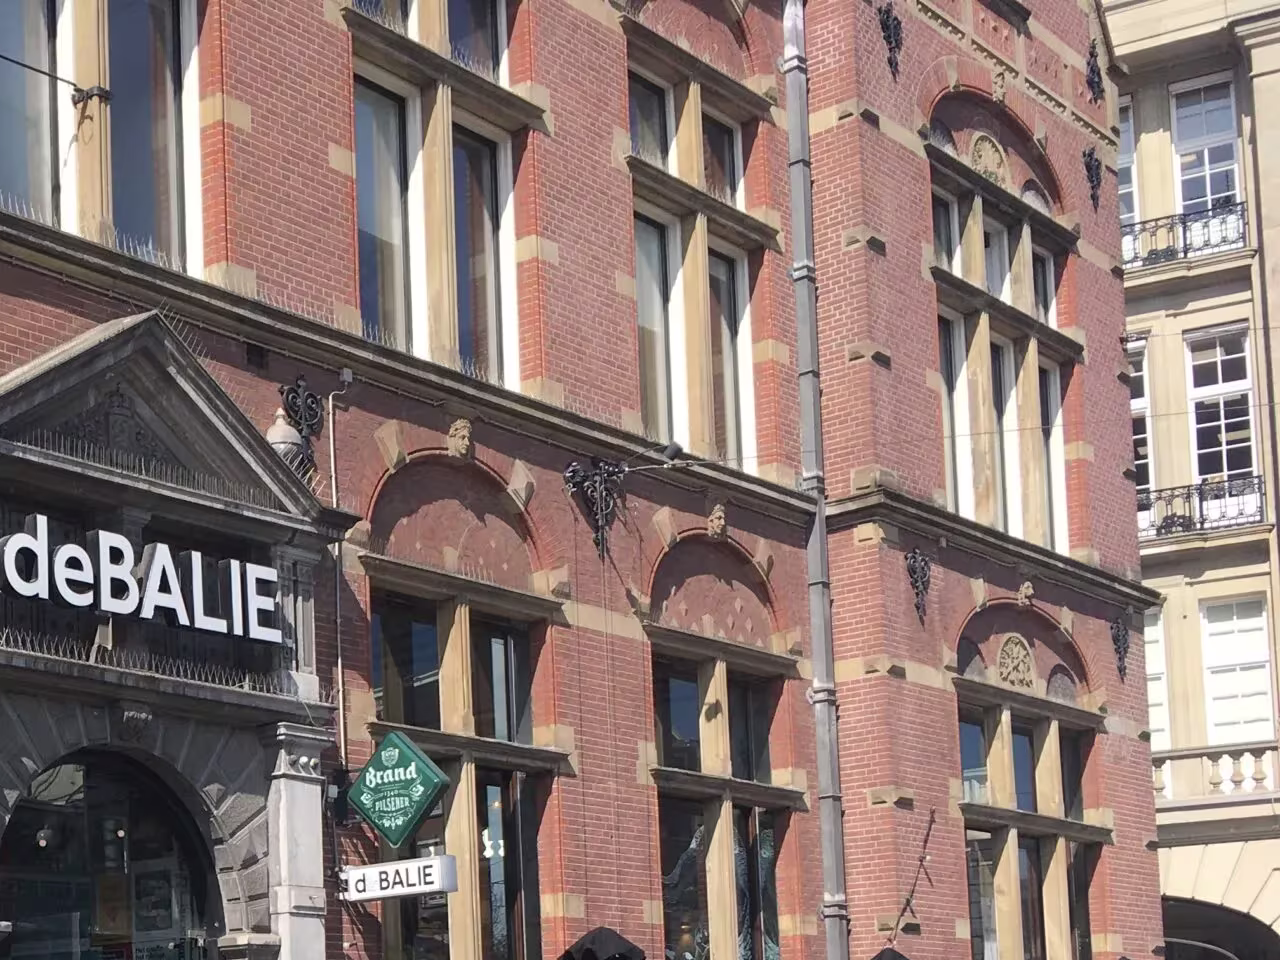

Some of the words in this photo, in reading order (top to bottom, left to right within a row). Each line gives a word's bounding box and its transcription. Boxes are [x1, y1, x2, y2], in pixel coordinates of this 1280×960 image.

[0, 513, 282, 643] deBALIE
[365, 762, 418, 788] Brand
[375, 796, 410, 812] PILSENER
[378, 864, 435, 891] BALIE
